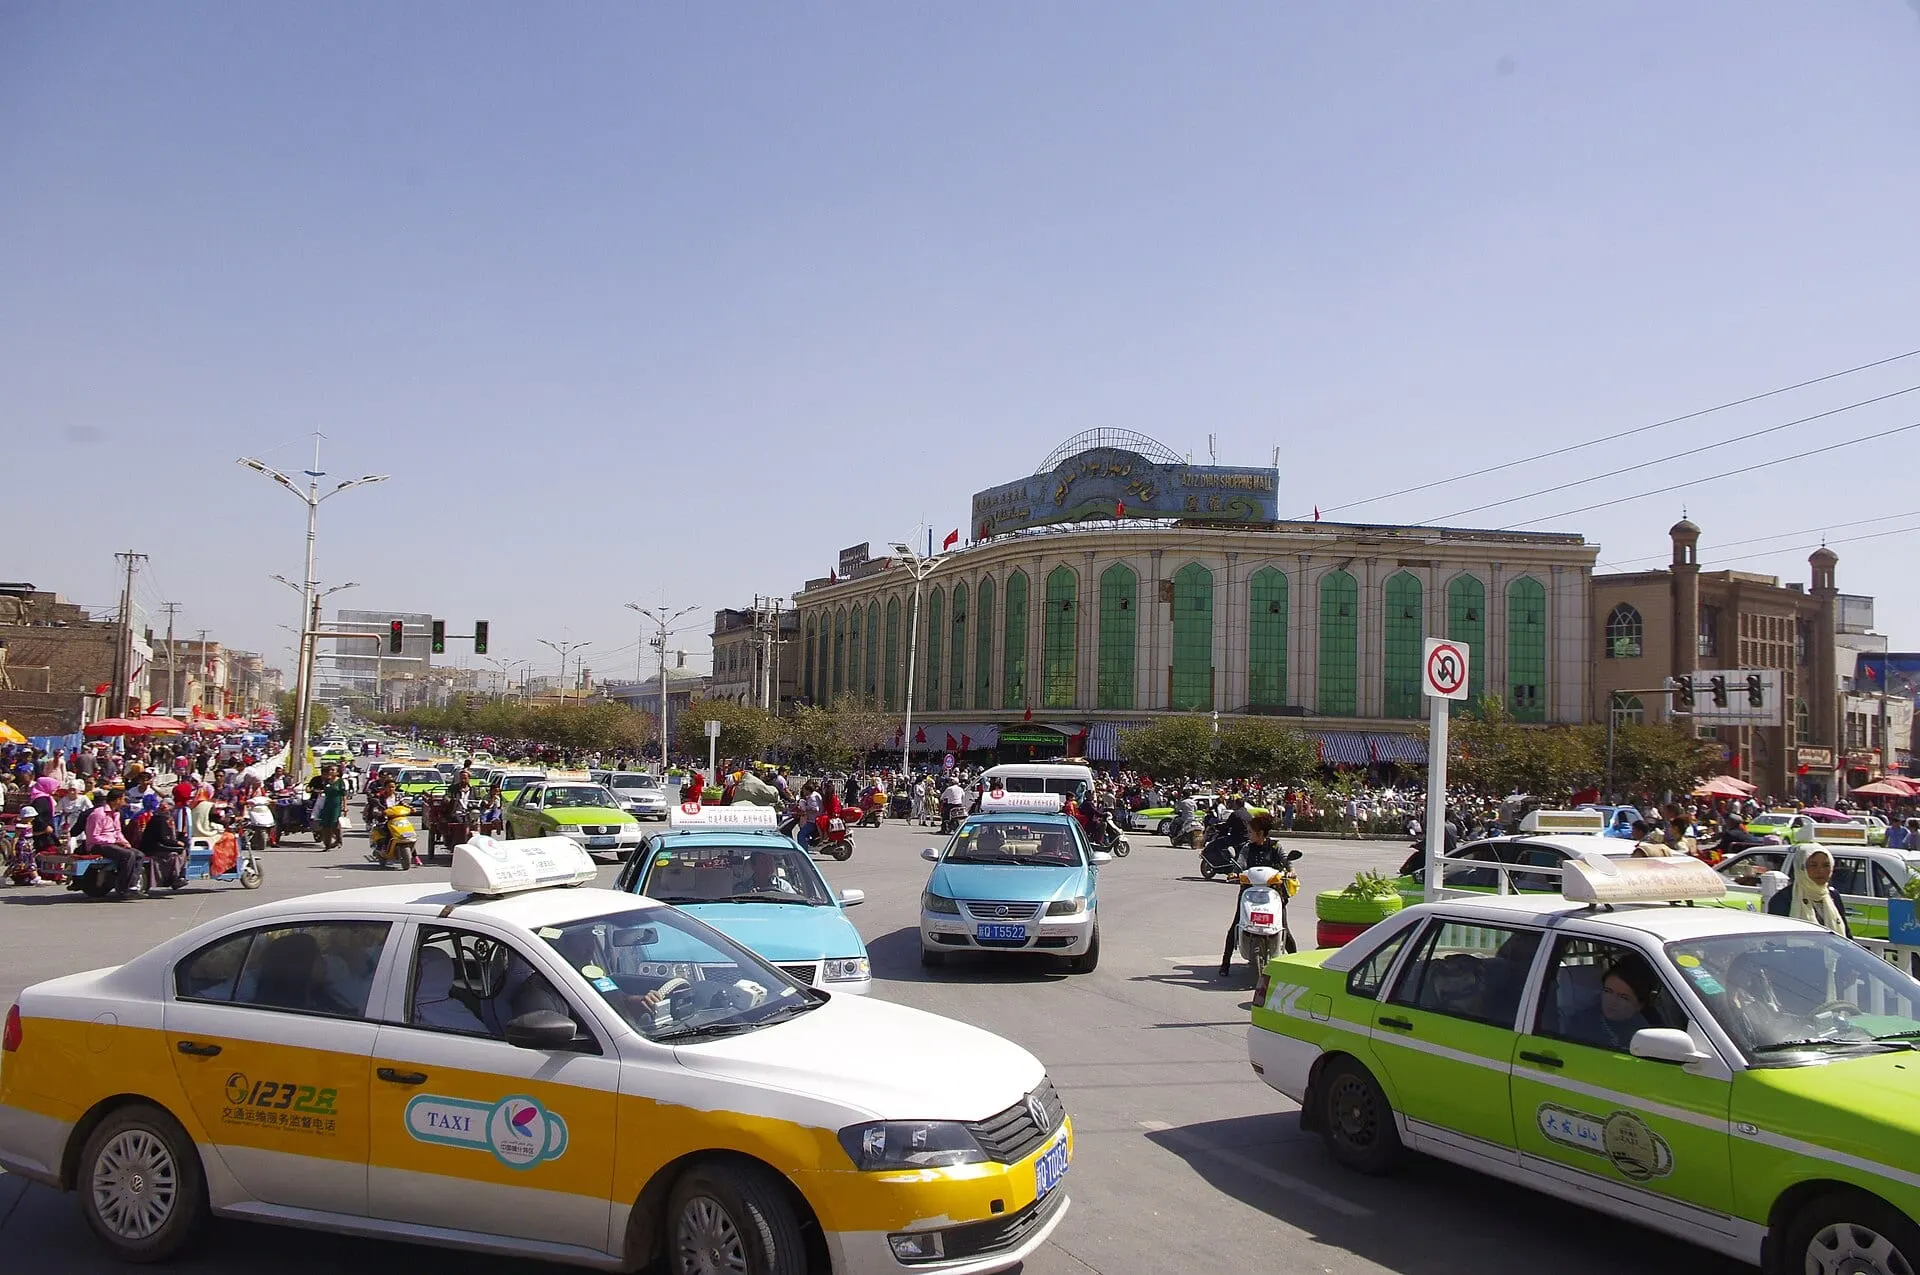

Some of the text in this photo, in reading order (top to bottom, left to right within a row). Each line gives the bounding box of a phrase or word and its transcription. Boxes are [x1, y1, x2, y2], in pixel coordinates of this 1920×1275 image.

[1220, 474, 1252, 490] SHOPPING
[1253, 475, 1273, 491] MALL
[247, 1080, 338, 1115] 12328
[223, 1106, 336, 1131] 交通运输服务监督电话
[428, 1112, 471, 1131] TAXI
